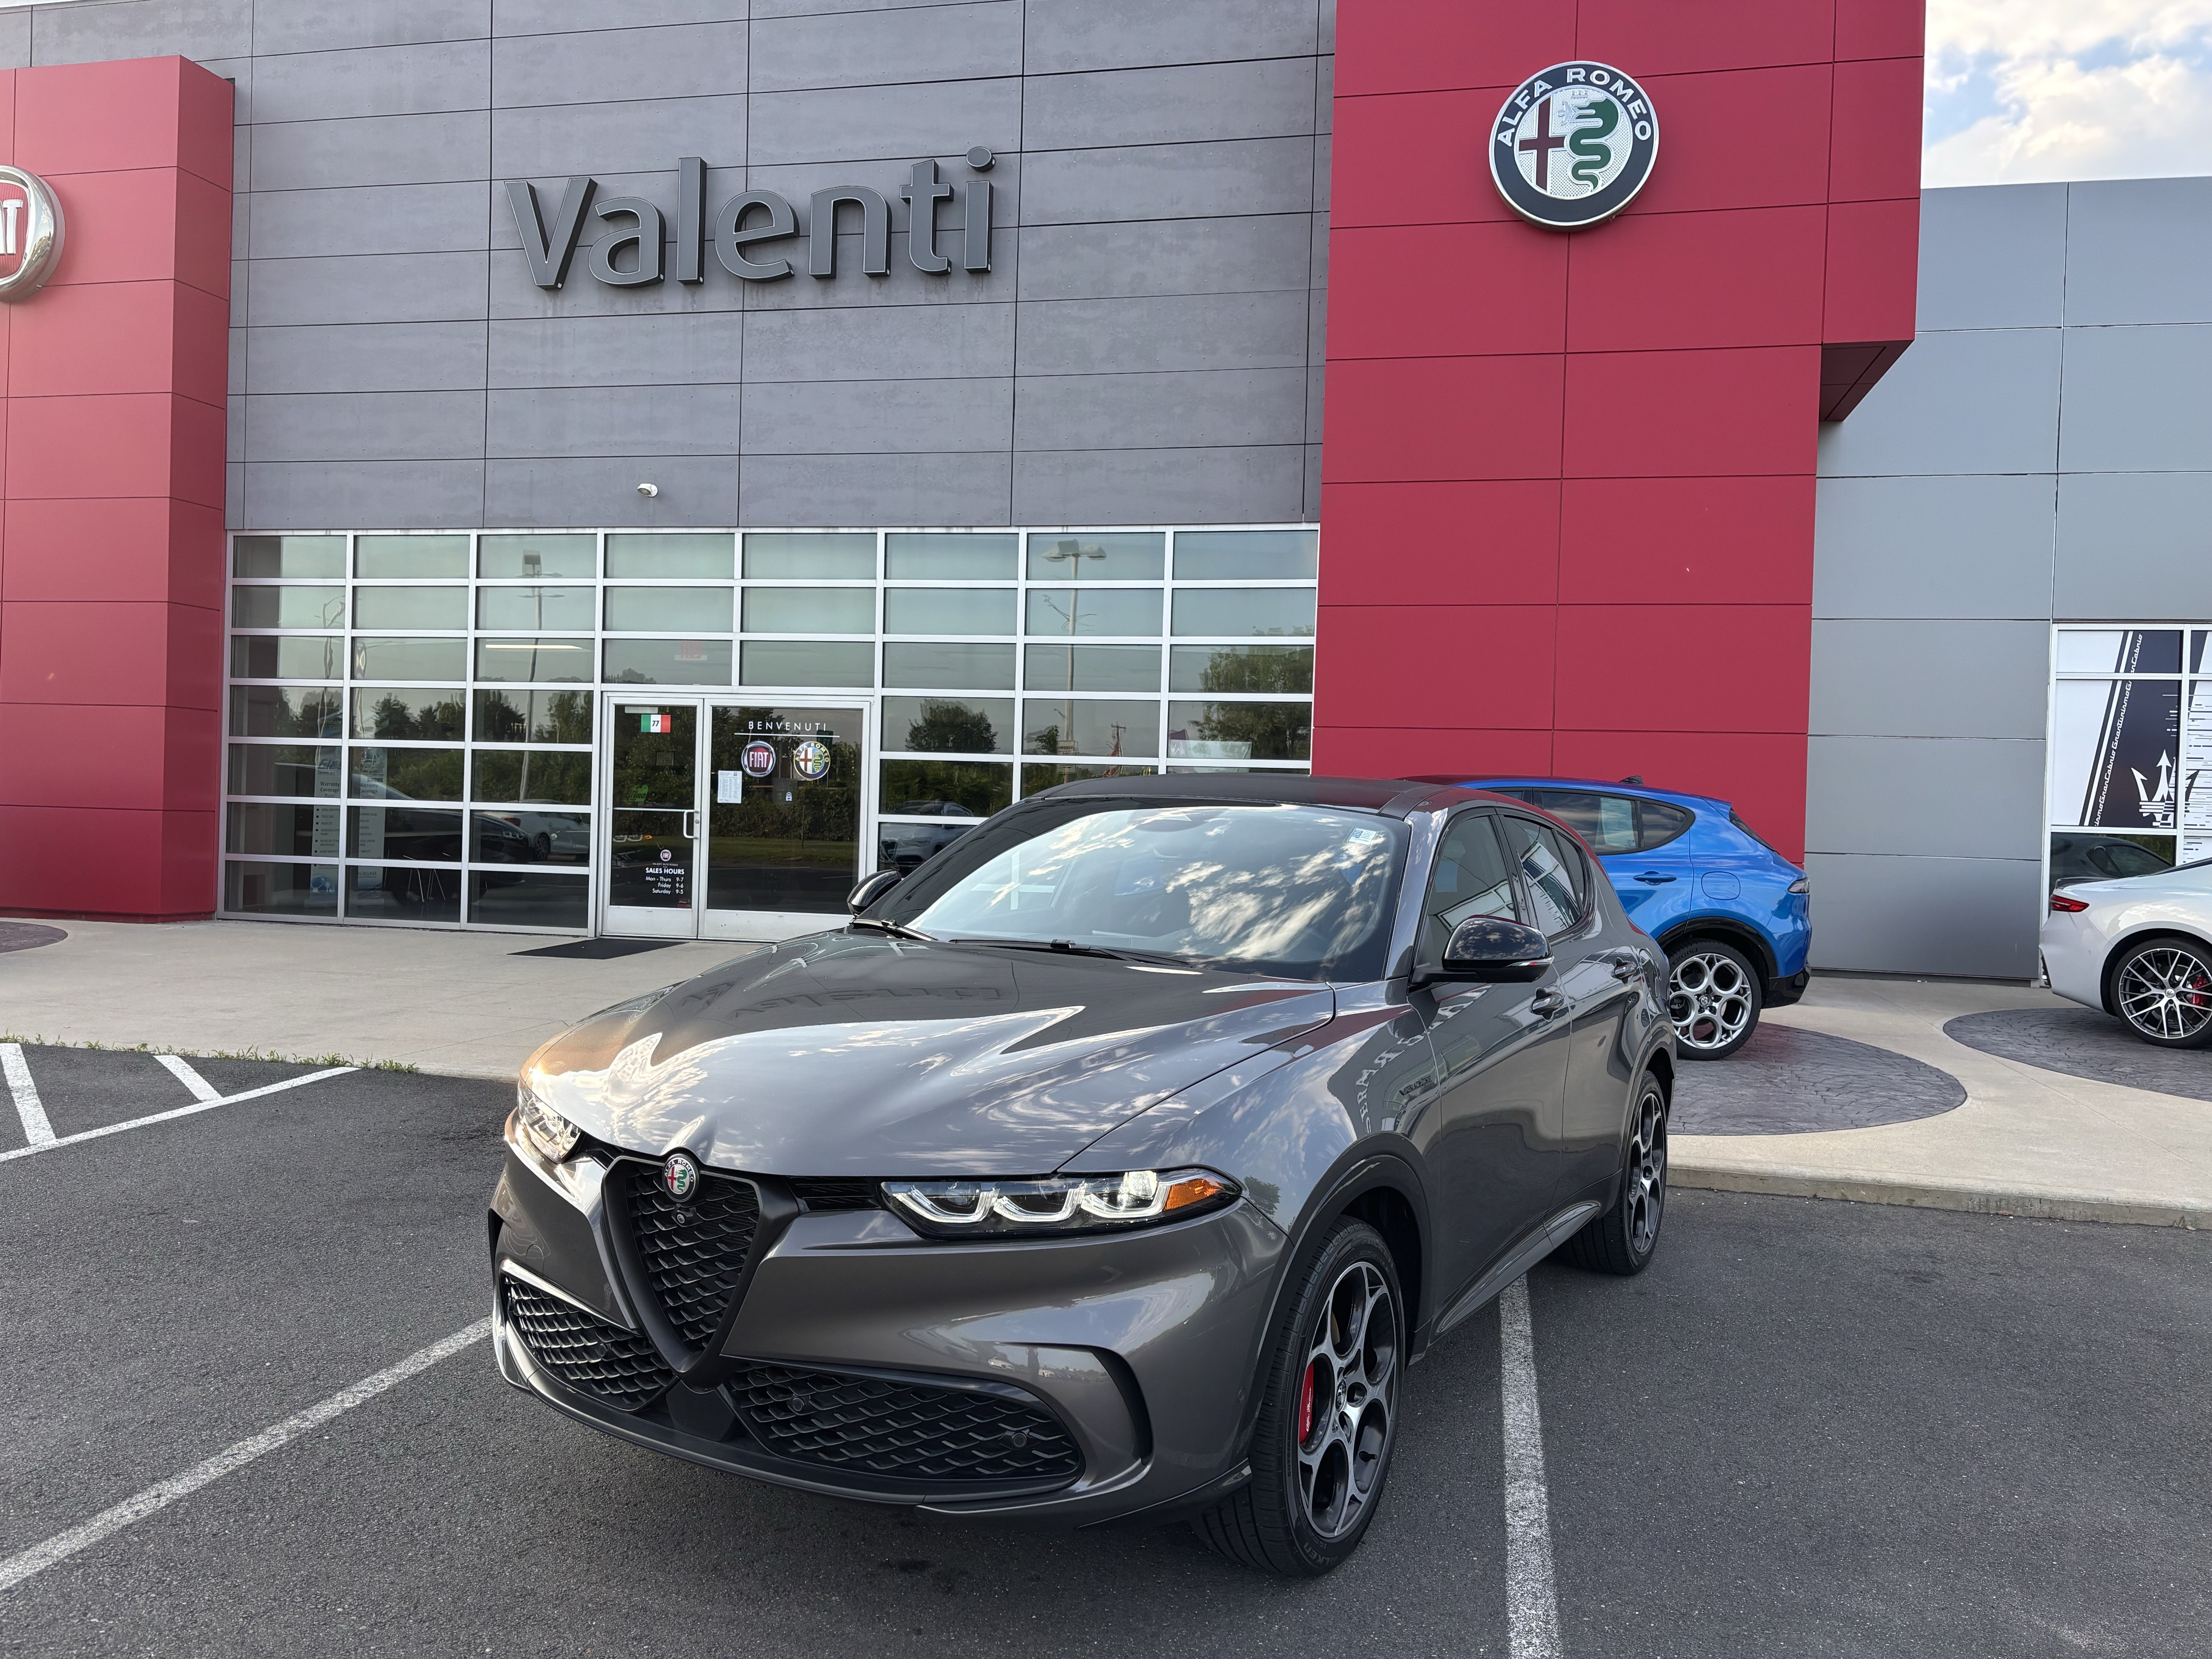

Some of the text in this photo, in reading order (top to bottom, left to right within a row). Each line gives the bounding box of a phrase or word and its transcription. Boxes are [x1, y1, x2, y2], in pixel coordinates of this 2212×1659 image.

[1497, 68, 1652, 147] ALFA ROMEO
[504, 146, 995, 289] Valenti
[749, 721, 826, 731] BENVENUTI
[749, 751, 769, 768] FIAT
[795, 742, 829, 763] ALFA ROMEO
[664, 1159, 694, 1182] ALFA ROMEO
